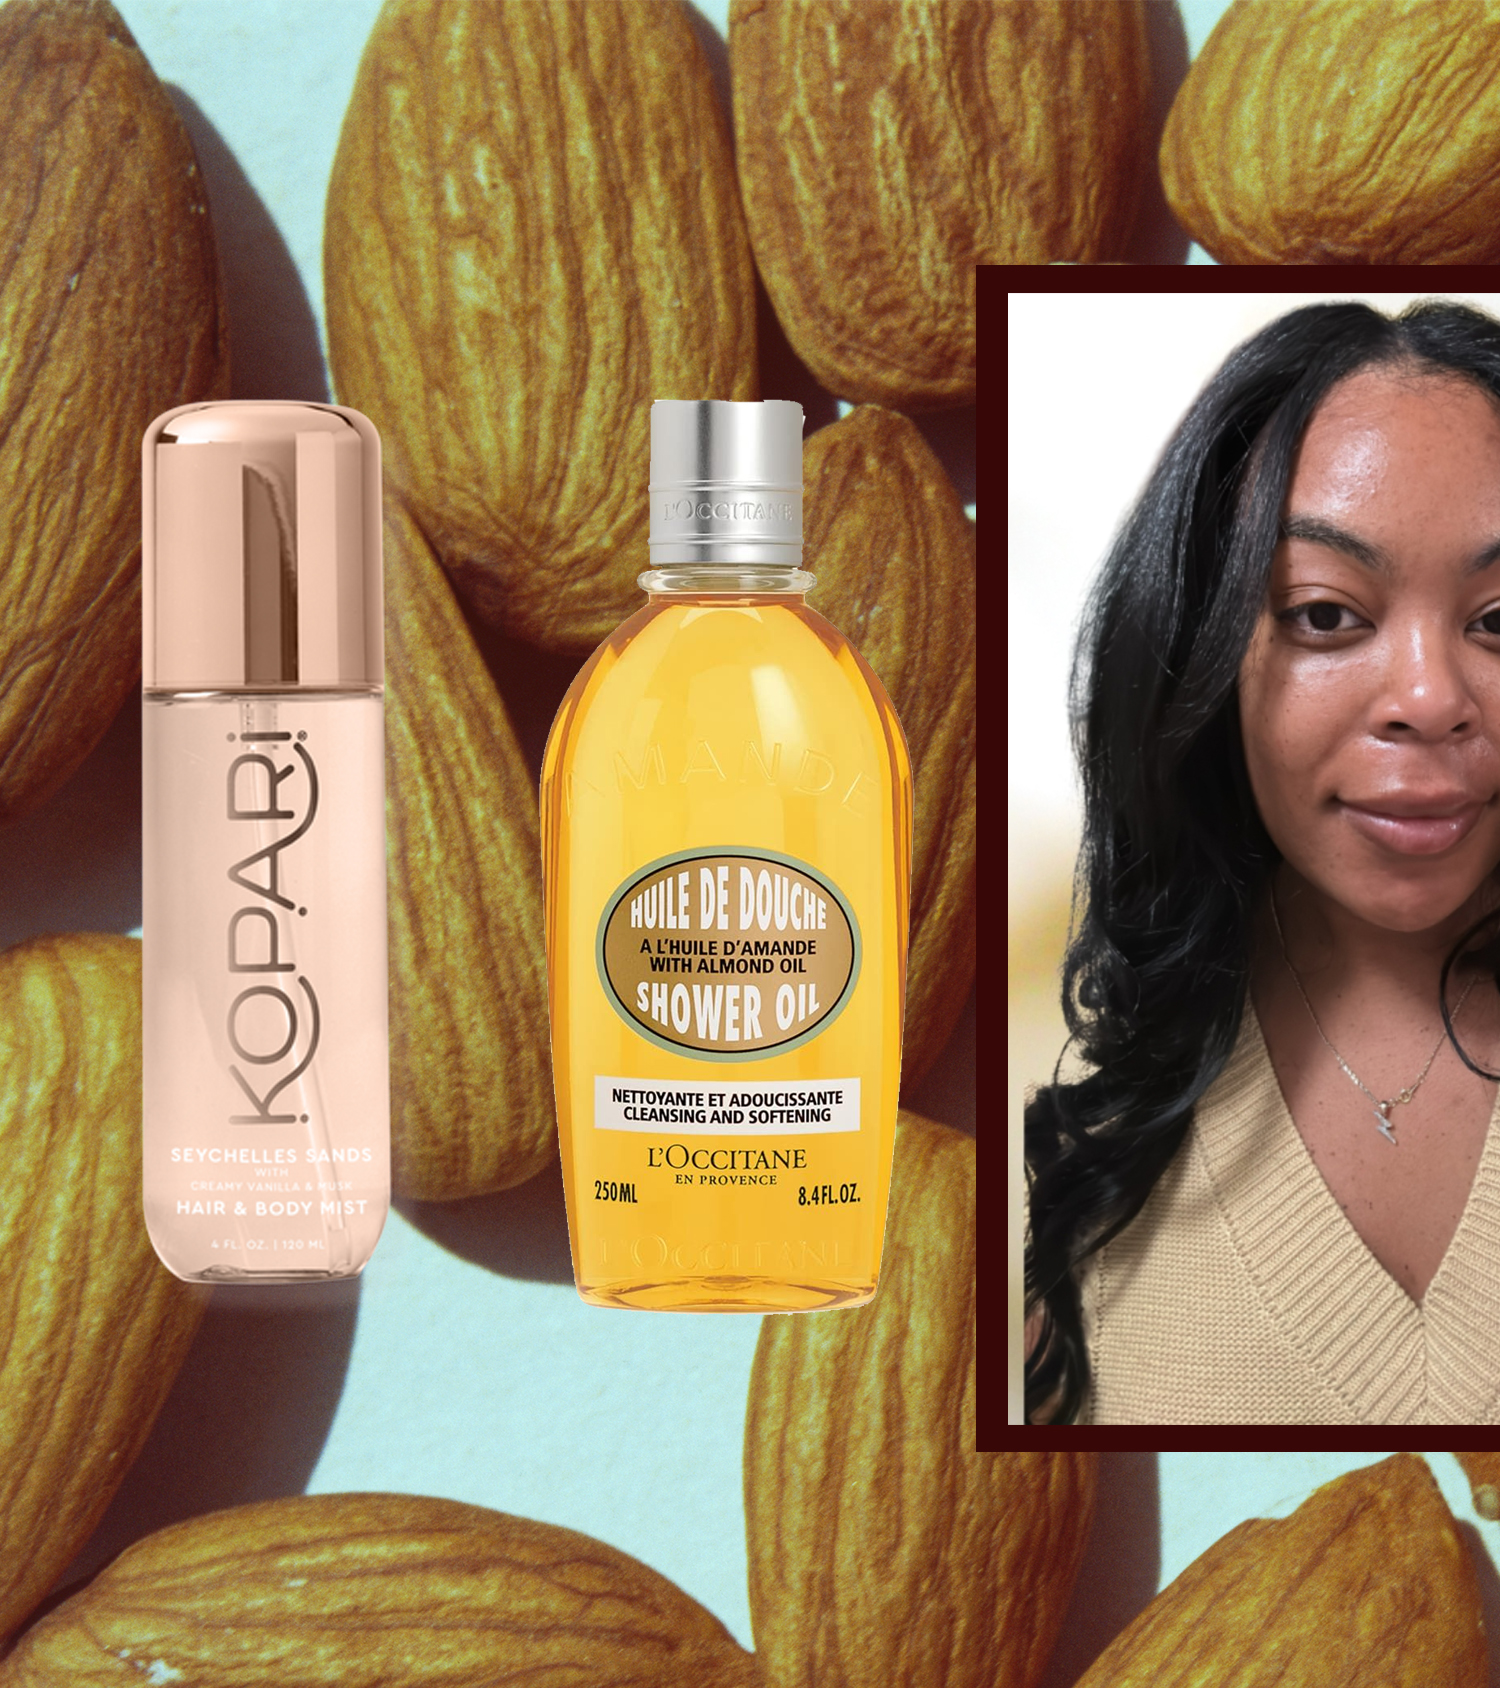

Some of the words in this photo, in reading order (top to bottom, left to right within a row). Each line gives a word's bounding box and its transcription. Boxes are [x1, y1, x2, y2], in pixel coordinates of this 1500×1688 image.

[631, 871, 690, 929] HUILE
[700, 866, 729, 930] DE
[739, 866, 827, 931] DOUCHE
[640, 938, 652, 954] A
[657, 938, 718, 955] L'HUILE
[723, 940, 816, 956] D'AMANDE
[650, 957, 692, 973] WITH
[697, 958, 774, 973] ALMOND
[779, 958, 806, 973] OIL
[637, 981, 763, 1041] SHOWER
[776, 983, 820, 1031] OIL
[612, 1088, 704, 1107] NETTOYANTE
[708, 1093, 726, 1107] ET
[729, 1090, 843, 1108] ADOUCISSANTE
[623, 1107, 706, 1123] CLEANSING
[709, 1109, 744, 1124] AND
[749, 1108, 831, 1123] SOFTENING
[171, 1147, 297, 1164] SEYCHELLES
[305, 1147, 373, 1163] SANDS
[647, 1144, 807, 1170] L'OCCITANE
[254, 1167, 289, 1177] WITH
[675, 1174, 693, 1184] EN
[699, 1174, 777, 1186] PROVENCE
[190, 1181, 243, 1191] CREAMY
[247, 1182, 301, 1192] VANILLA
[305, 1182, 314, 1191] &
[317, 1181, 353, 1191] MUSK
[176, 1200, 226, 1215] HAIR
[234, 1201, 247, 1216] &
[255, 1201, 313, 1216] BODY
[320, 1199, 368, 1215] MIST
[211, 1240, 219, 1249] 4
[224, 1240, 241, 1250] FL.
[246, 1240, 269, 1250] OZ.
[282, 1239, 304, 1250] 120
[309, 1240, 325, 1250] ML
